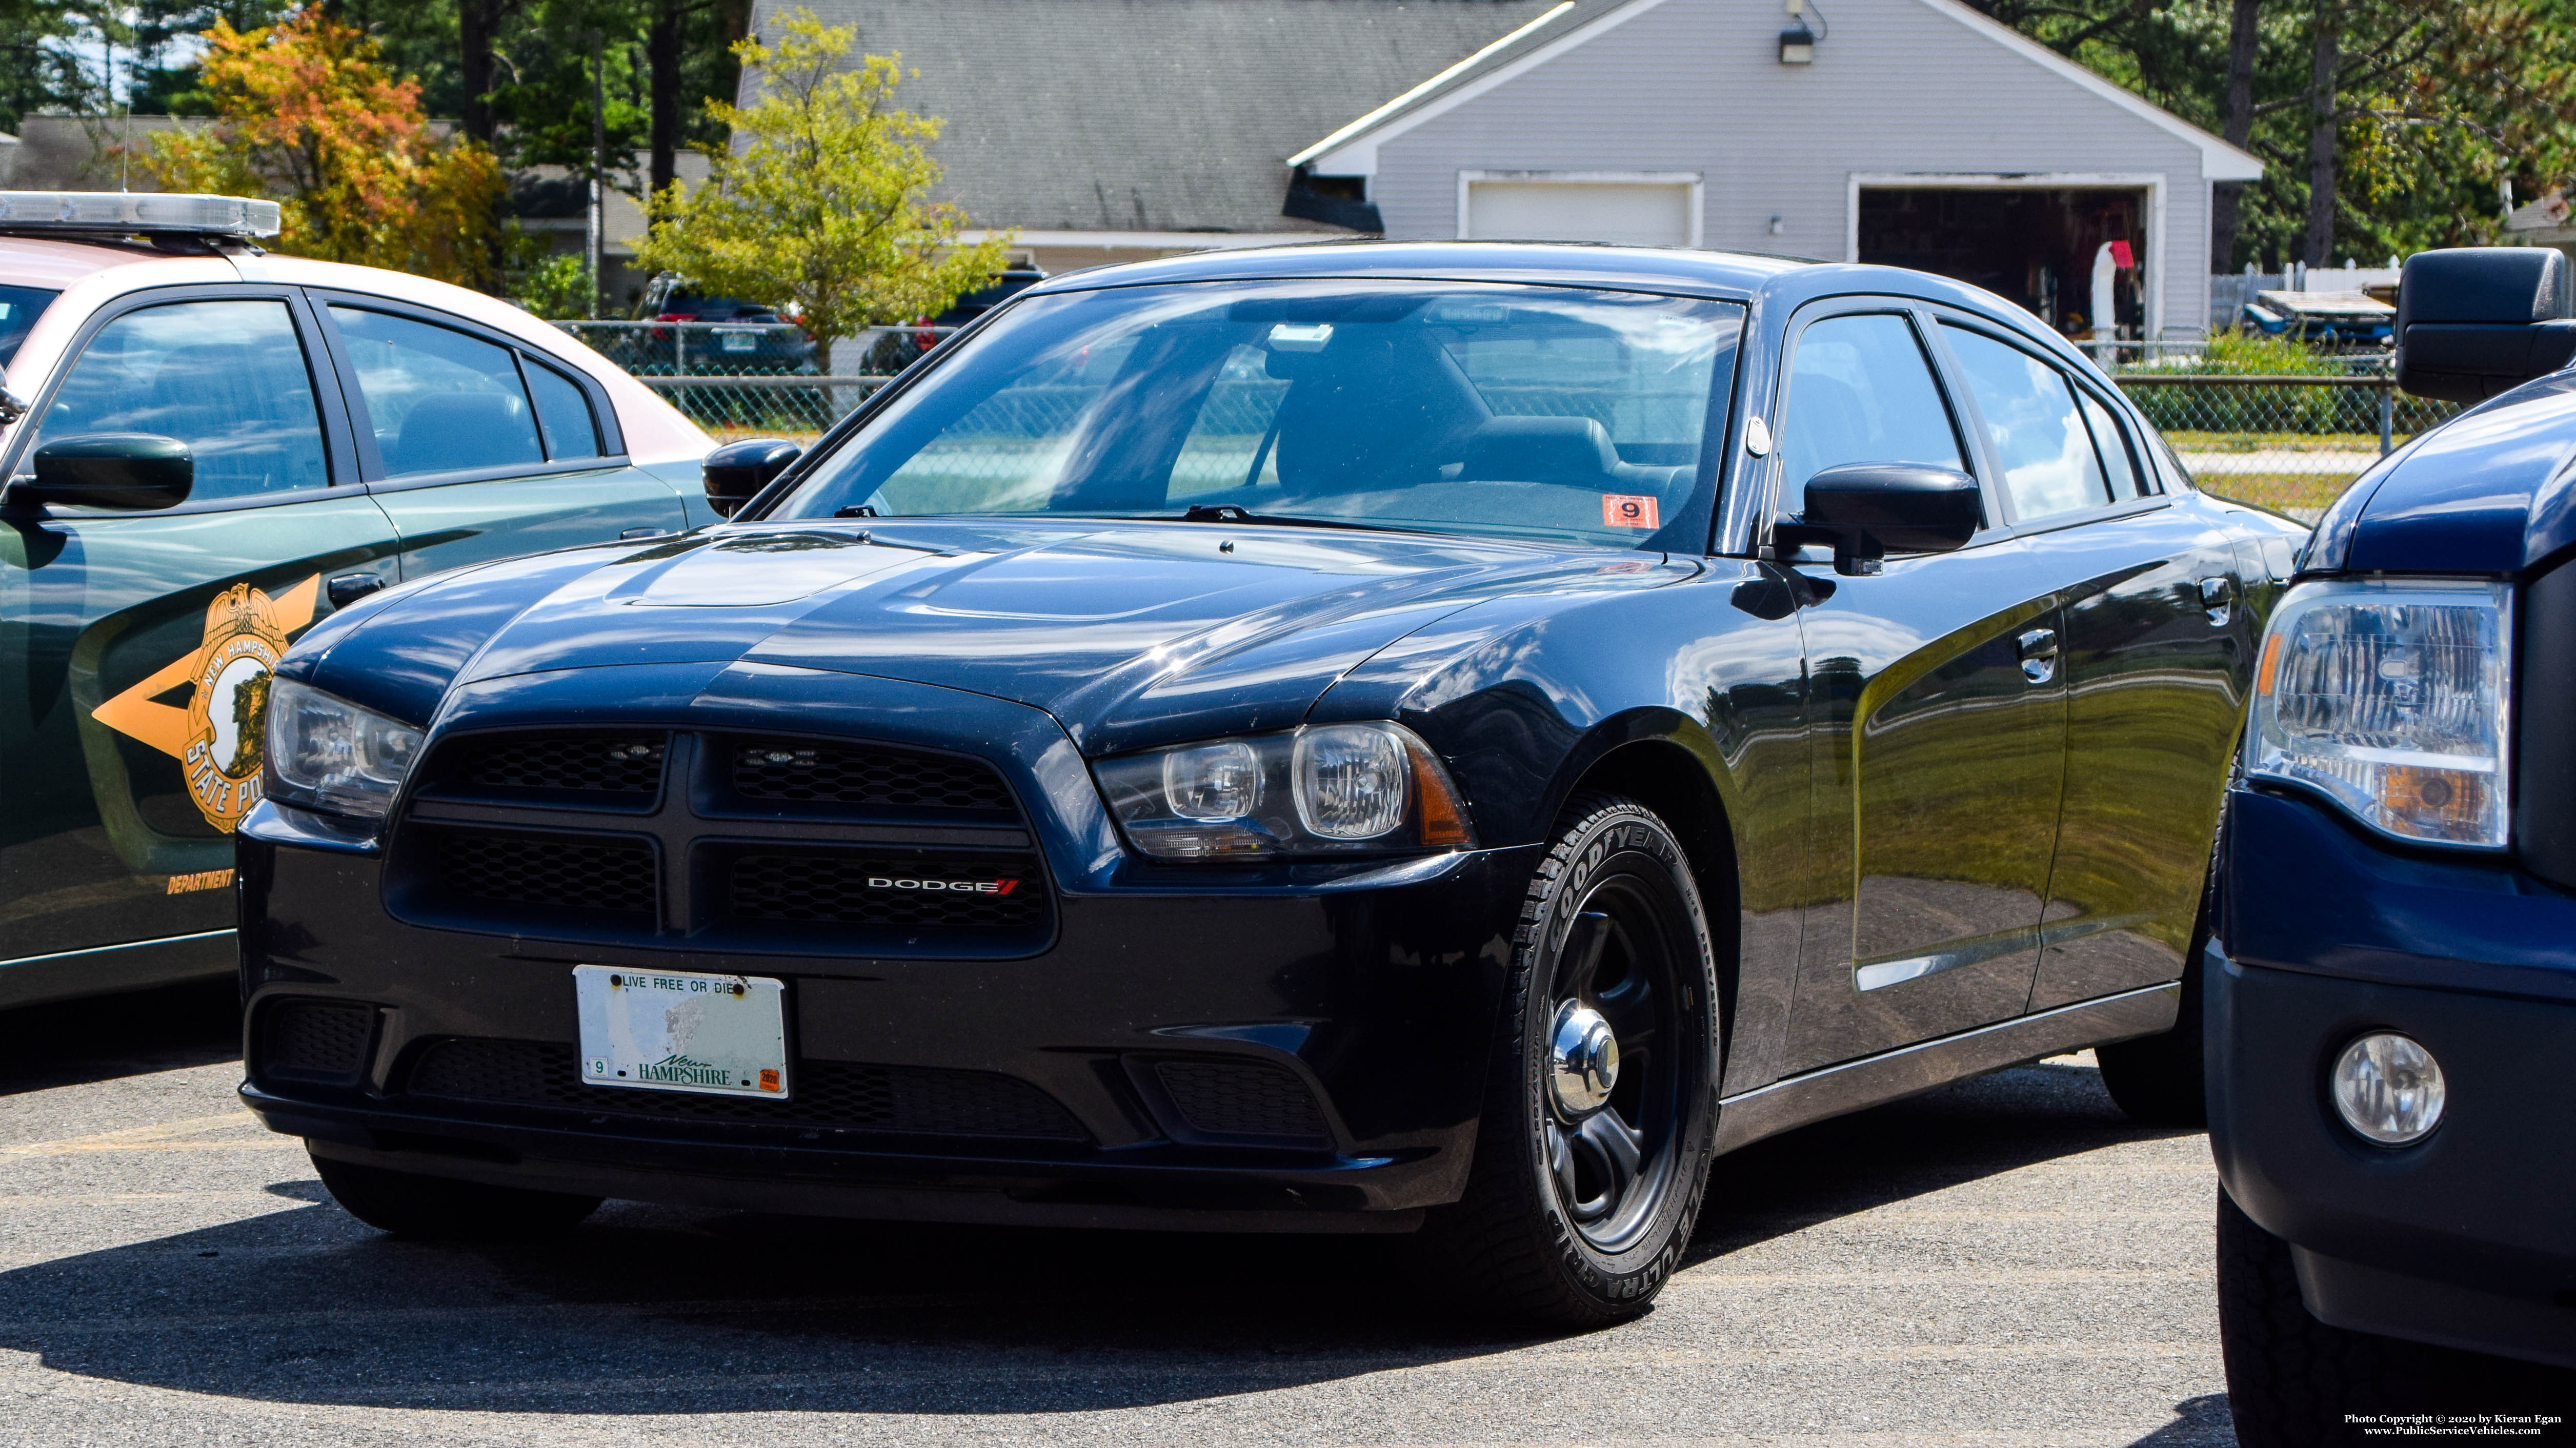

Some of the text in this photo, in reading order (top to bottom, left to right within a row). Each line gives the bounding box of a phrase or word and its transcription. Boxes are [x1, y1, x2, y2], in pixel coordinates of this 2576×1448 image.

[1622, 502, 1640, 518] 9
[204, 653, 224, 687] NEW
[187, 739, 231, 812] STATE
[167, 868, 235, 894] DEPARTMENT
[869, 878, 999, 892] DODGE
[1550, 826, 1678, 952] GOODYEAR
[622, 975, 733, 994] LIVE FREE OR DIE
[596, 1061, 603, 1073] 9
[638, 1060, 733, 1085] HAMPSHIRE
[654, 1054, 712, 1067] New
[762, 1072, 777, 1084] 2020
[1547, 1210, 1599, 1288] GRIP
[1607, 1245, 1674, 1298] ULTRA
